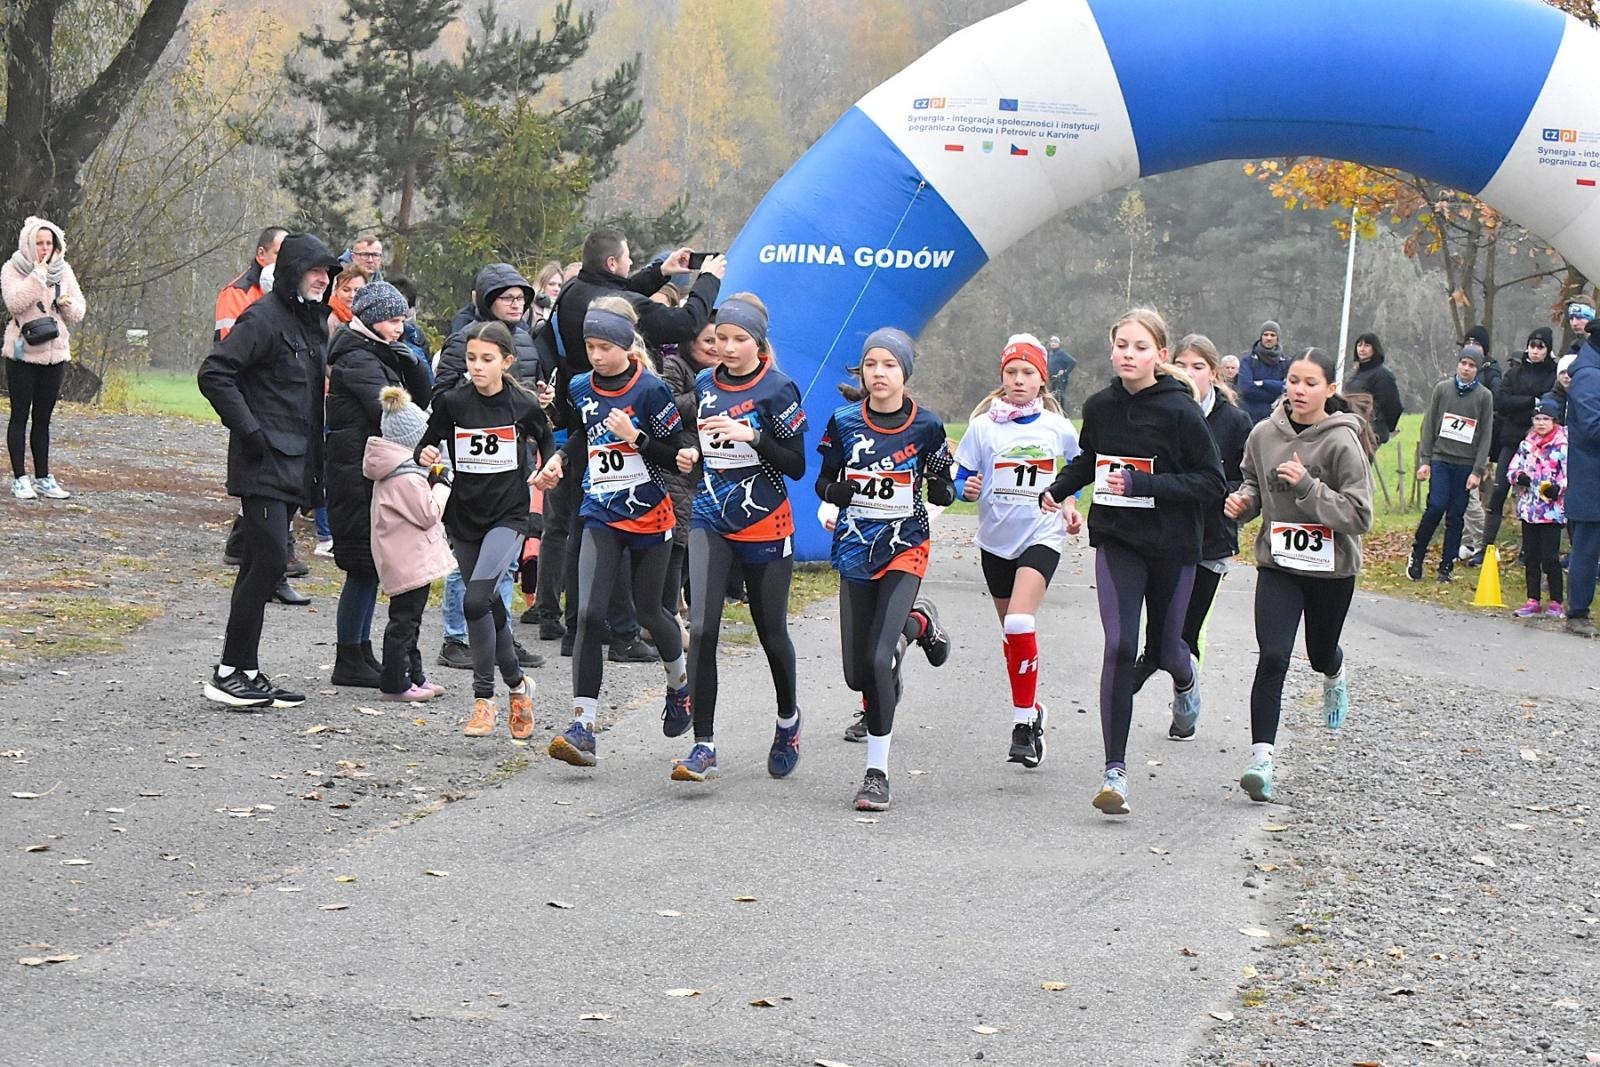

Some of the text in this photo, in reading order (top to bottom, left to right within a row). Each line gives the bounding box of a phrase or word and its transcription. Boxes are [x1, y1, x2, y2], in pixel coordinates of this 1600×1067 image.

[907, 114, 944, 123] Synergia
[952, 114, 994, 125] integracja
[997, 117, 1053, 128] społeczności
[1060, 121, 1100, 132] instytucji
[908, 124, 955, 132] pogranicza
[958, 124, 993, 134] Godowa
[1001, 127, 1036, 137] Petrovic
[1046, 130, 1079, 139] Karvine
[1537, 146, 1576, 157] Synergia
[1539, 157, 1587, 166] pogranicza
[759, 244, 955, 270] GMINA GODÓW
[1451, 419, 1467, 431] 47
[469, 434, 499, 456] 58
[598, 449, 625, 474] 30
[1014, 465, 1038, 487] 11
[861, 477, 895, 500] 48
[1282, 529, 1323, 552] 103
